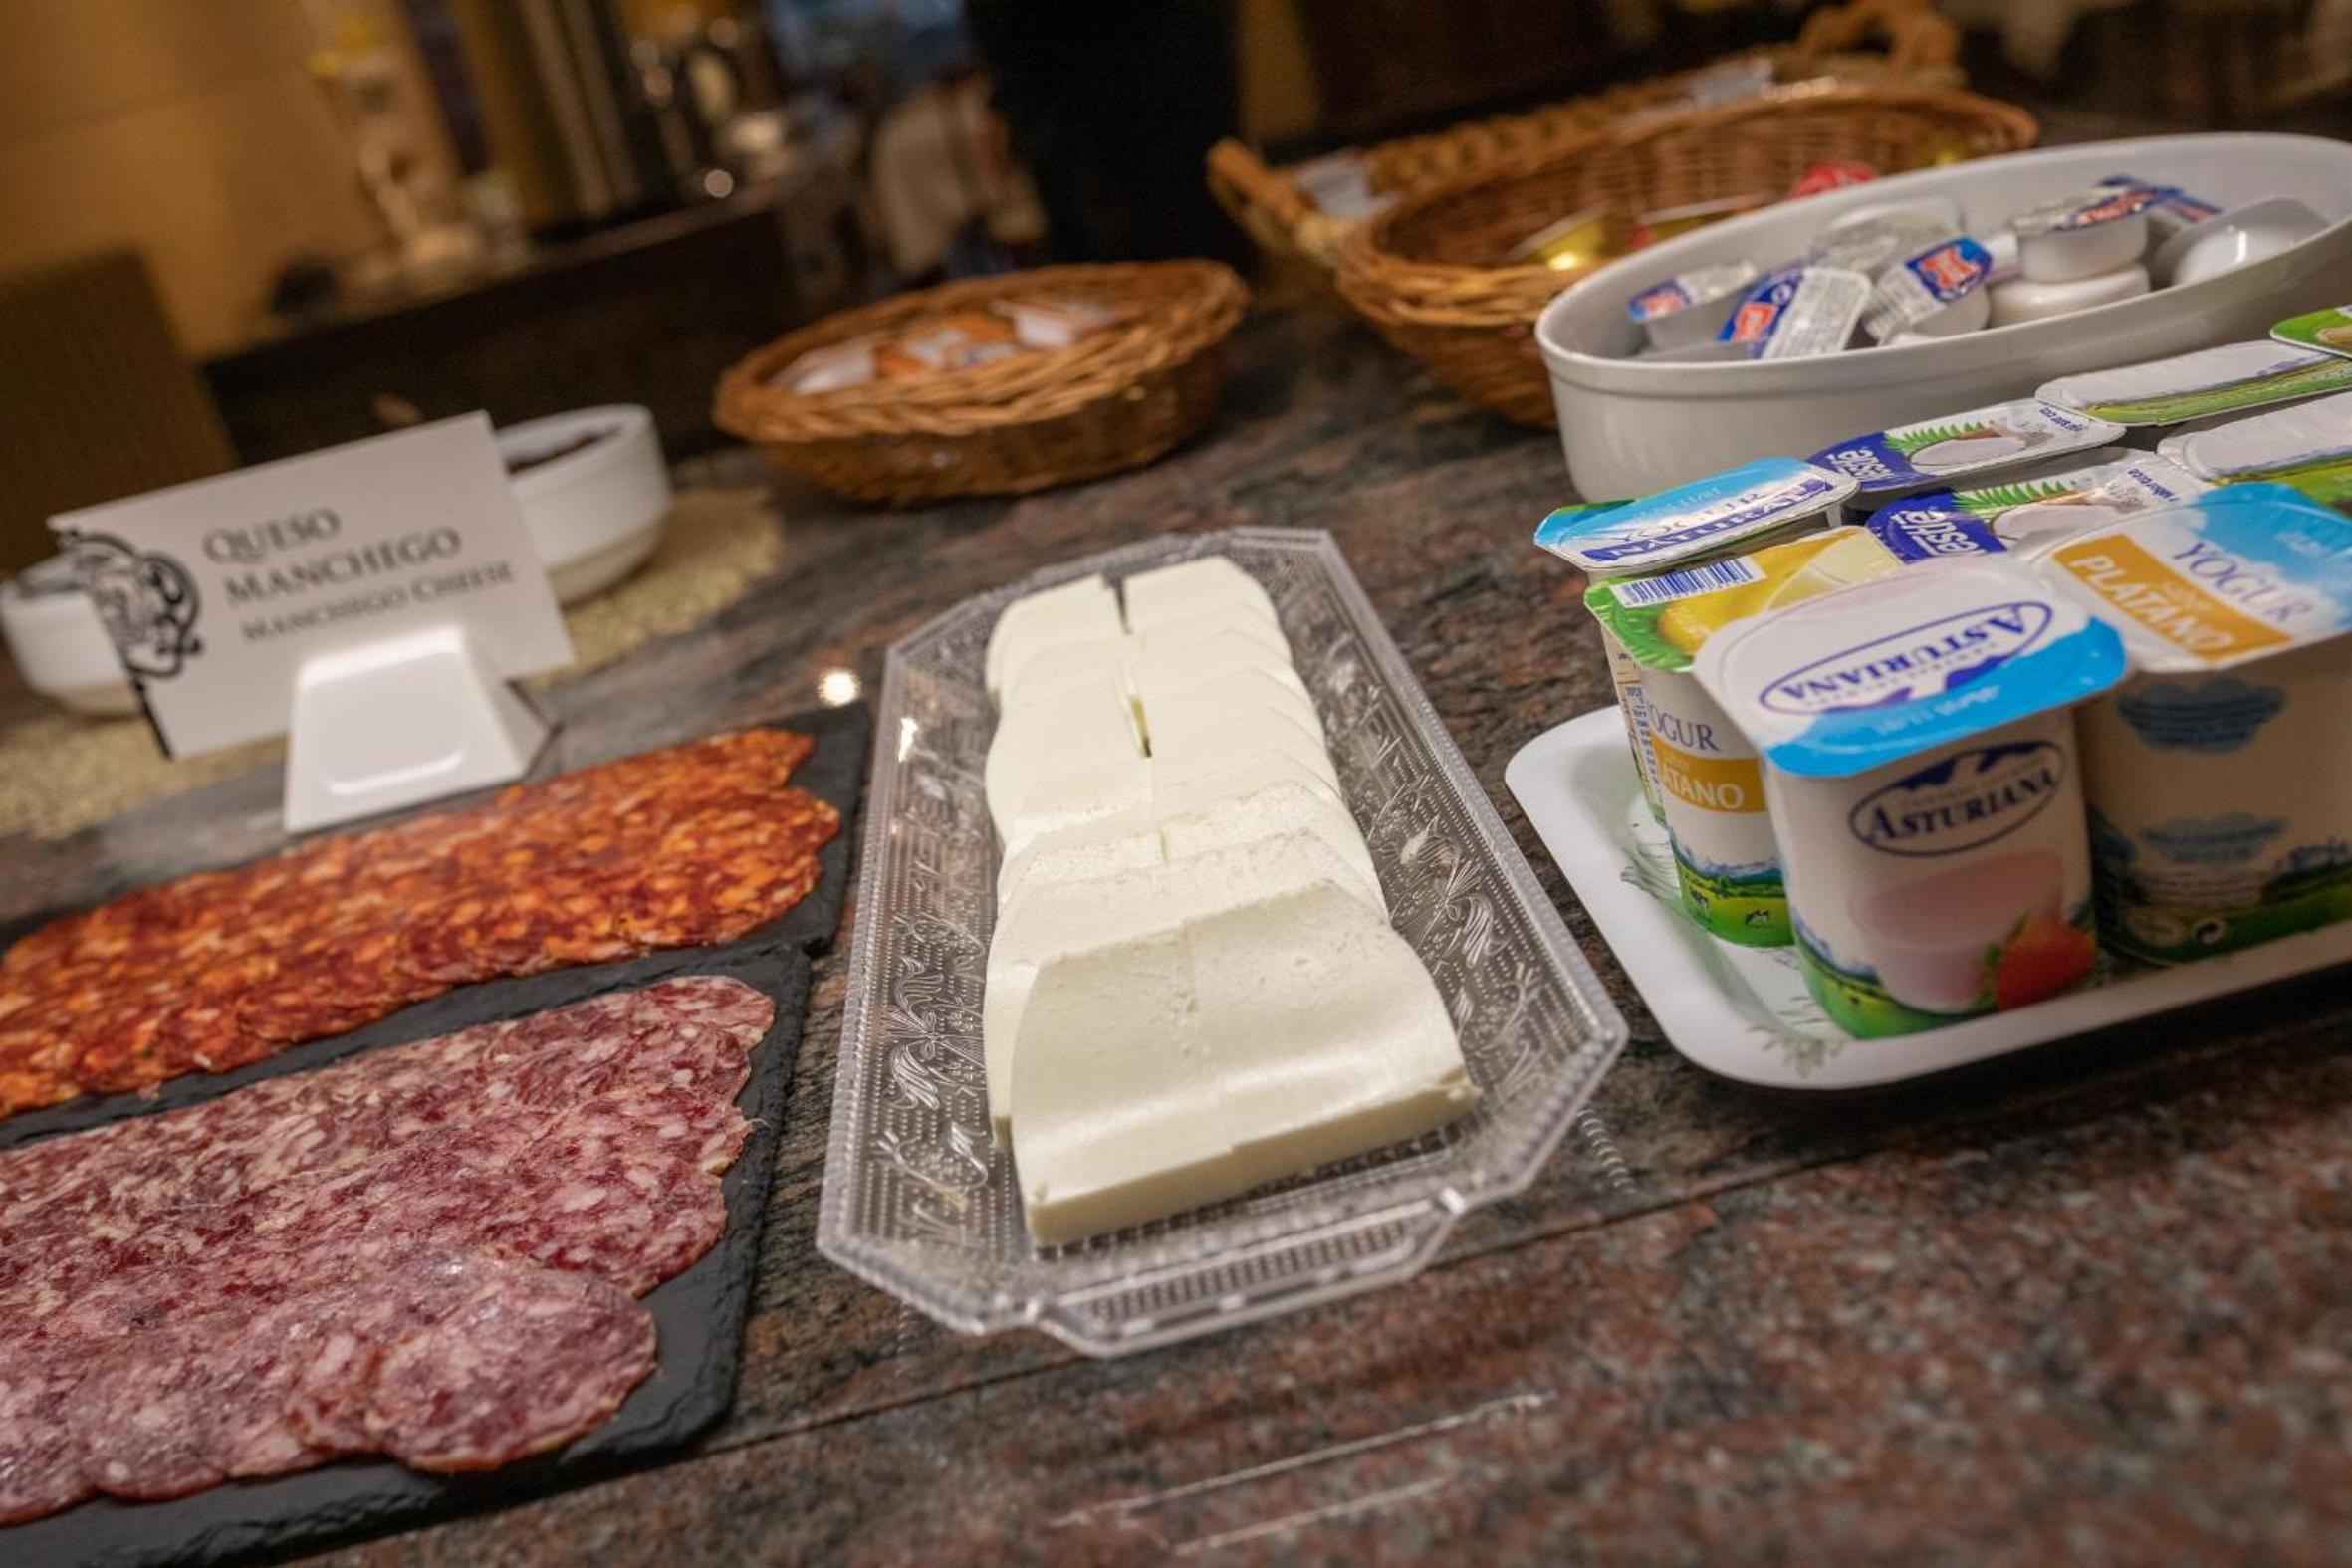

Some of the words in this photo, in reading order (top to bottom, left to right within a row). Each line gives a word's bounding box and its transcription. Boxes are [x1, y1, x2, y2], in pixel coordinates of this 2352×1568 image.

[1827, 449, 1894, 481] estlé
[201, 506, 342, 565] QUESO
[1609, 482, 1820, 556] NATURAL
[1890, 509, 1990, 557] estlé
[223, 525, 462, 608] MANCHEGO
[2068, 554, 2235, 651] PLATANO
[2173, 542, 2312, 622] YOGUR
[1779, 604, 2026, 701] ASTURIANA
[1648, 703, 1722, 752] OGUR
[1863, 769, 2058, 841] ASTURIANA
